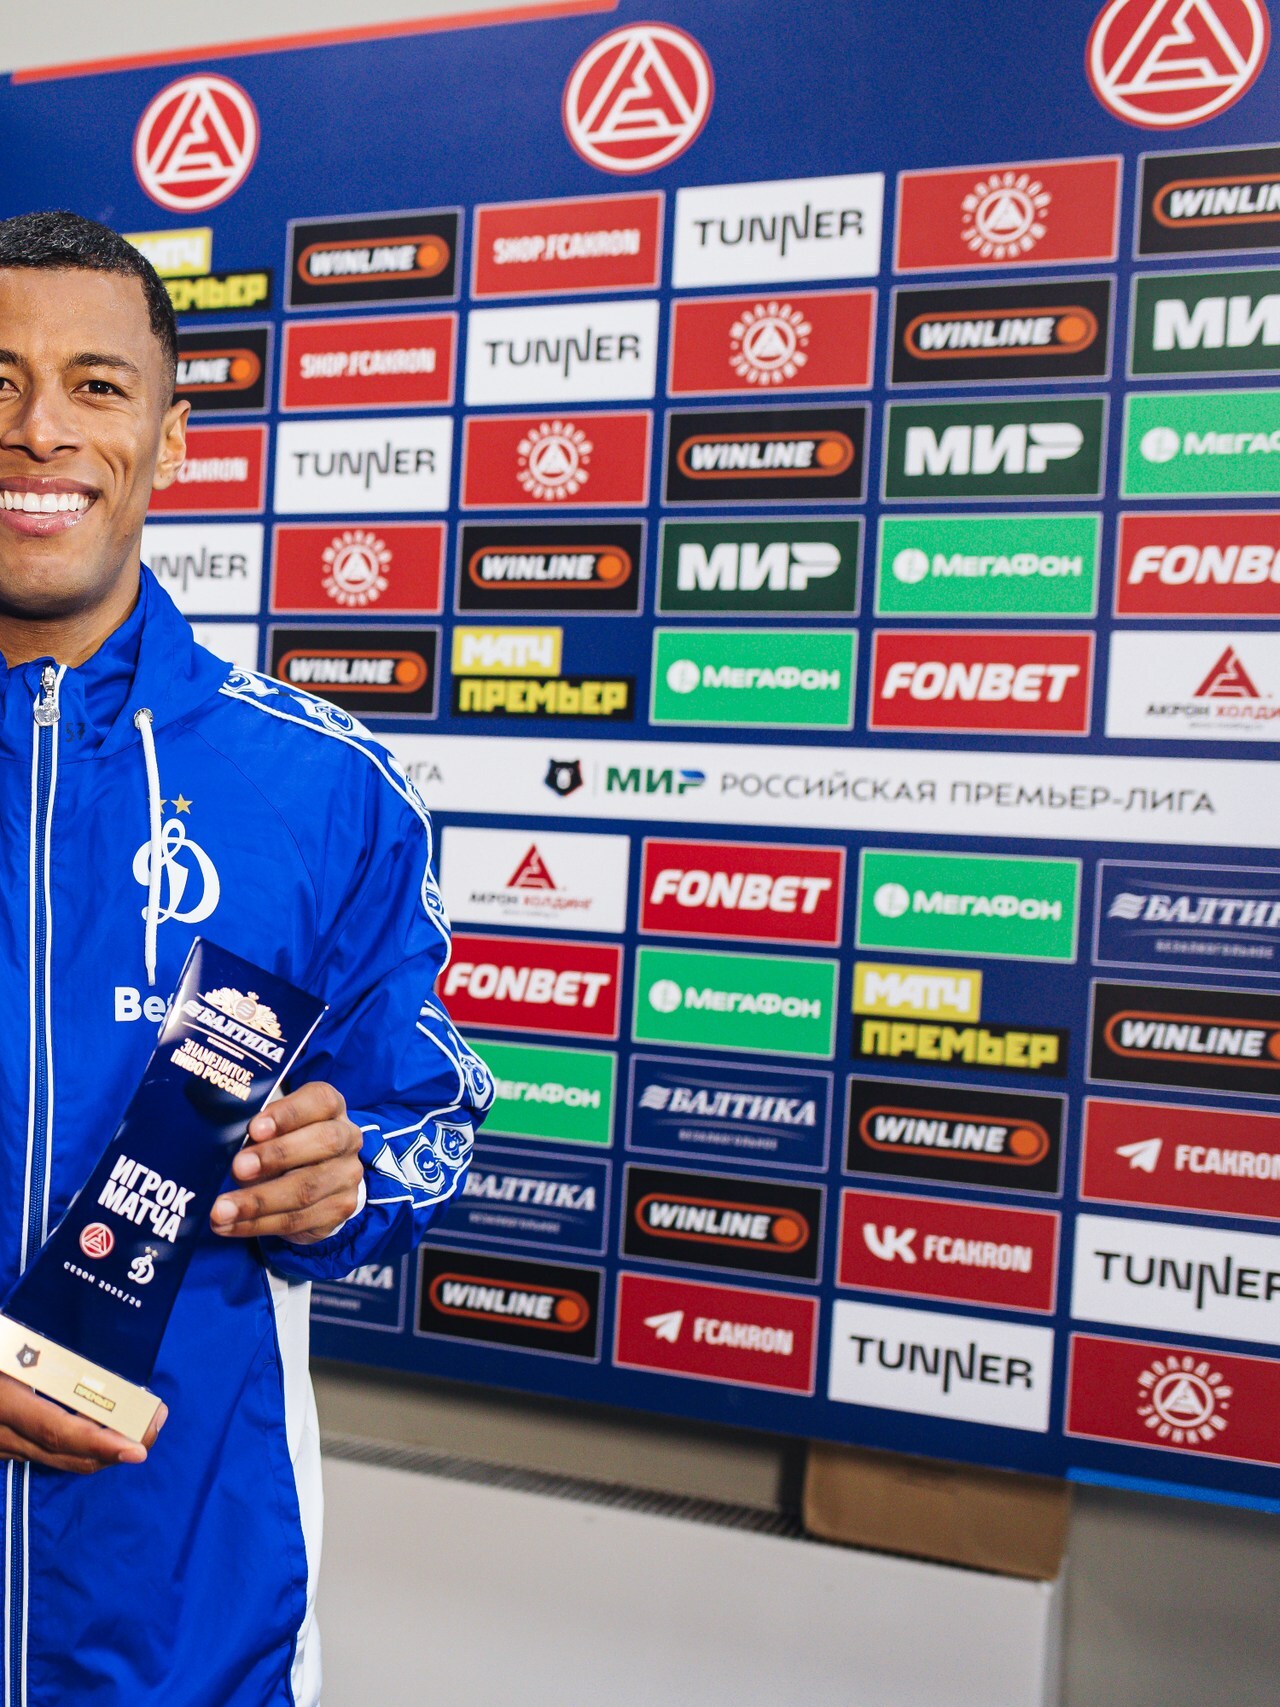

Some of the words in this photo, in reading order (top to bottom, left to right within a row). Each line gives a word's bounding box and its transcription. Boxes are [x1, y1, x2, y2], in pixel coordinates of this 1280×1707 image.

[694, 203, 863, 257] TUNNER
[308, 245, 418, 278] WINLINE
[920, 318, 1054, 349] WINLINE
[1153, 294, 1280, 350] МИ
[485, 328, 640, 378] TUNNER
[293, 441, 435, 490] TUNNER
[692, 441, 814, 470] WINLINE
[905, 423, 1083, 476] МИР
[483, 555, 595, 580] WINLINE
[678, 543, 841, 590] МИР
[461, 634, 554, 667] МАТЧ
[289, 659, 394, 685] WINLINE
[882, 662, 1080, 702] FONBET
[459, 680, 627, 714] ПРЕМЬЕР
[607, 768, 705, 794] МИР
[720, 771, 937, 803] РОССИЙСКАЯ
[950, 781, 1216, 815] ПРЕМЬЕР-ЛИГА
[651, 869, 831, 913] FONBET
[444, 963, 610, 1007] FONBET
[863, 971, 971, 1012] МАТЧ
[196, 1006, 285, 1064] БАЛТИКА
[862, 1020, 1059, 1068] ПРЕМЬЕР
[1122, 1021, 1265, 1056] WINLINE
[670, 1086, 818, 1127] БАЛТИКА
[876, 1116, 1007, 1152] WINLINE
[109, 1154, 196, 1218] ИГРОК
[462, 1171, 597, 1212] БАЛТИКА
[97, 1179, 182, 1244] МАТЧА
[650, 1203, 770, 1239] WINLINE
[63, 1261, 96, 1284] СЕЗОН
[924, 1235, 1032, 1273] FCAKRON
[443, 1282, 553, 1319] WINLINE
[693, 1317, 793, 1355] FCAKRON
[850, 1335, 1032, 1394] TUNNER
